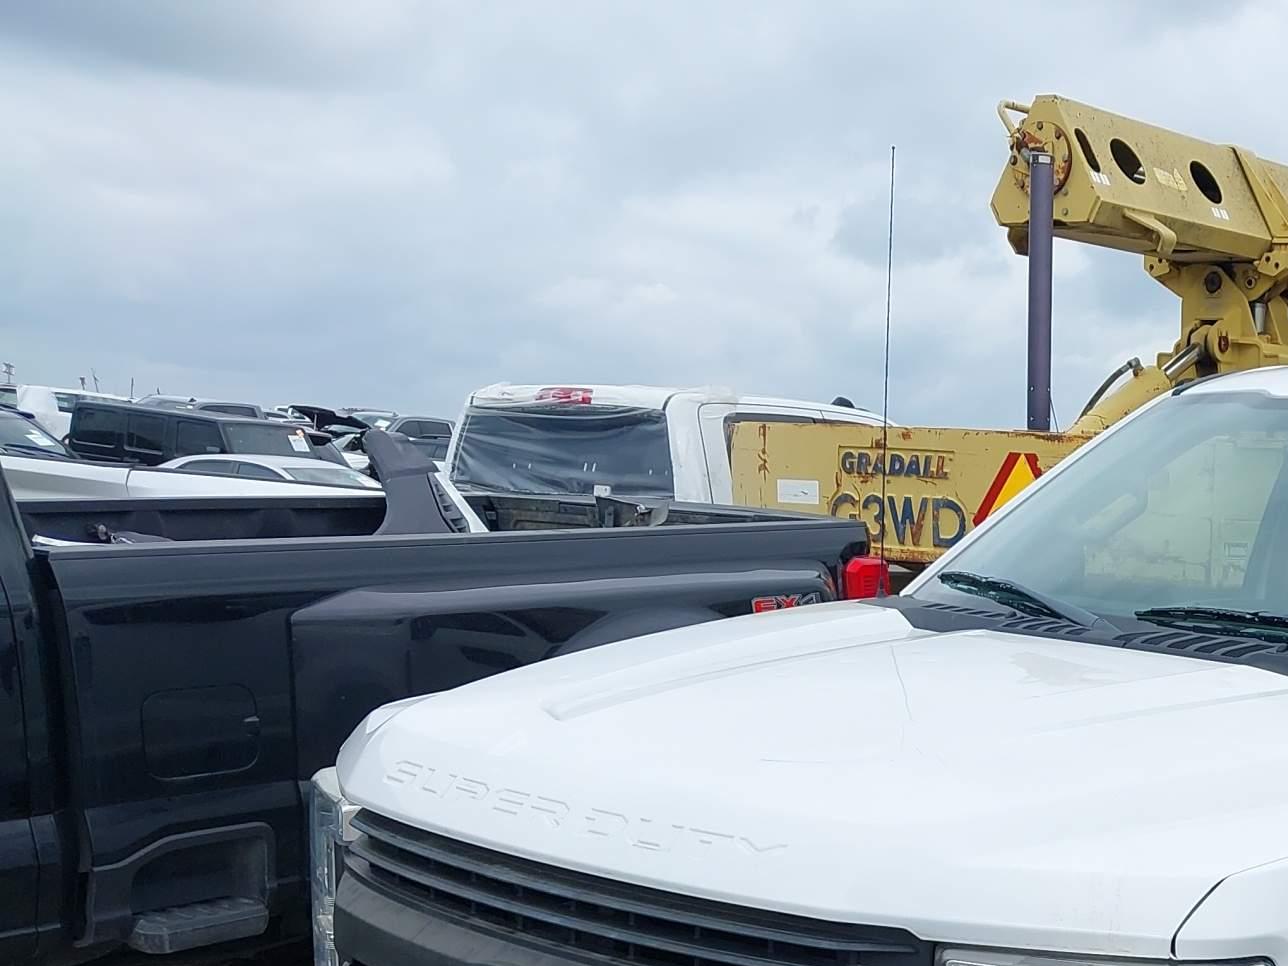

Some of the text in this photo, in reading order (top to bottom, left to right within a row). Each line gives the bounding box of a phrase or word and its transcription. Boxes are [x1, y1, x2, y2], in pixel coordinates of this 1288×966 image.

[841, 451, 949, 479] GRADALL
[751, 592, 820, 614] FX4
[384, 759, 789, 854] SUPER DUTY
